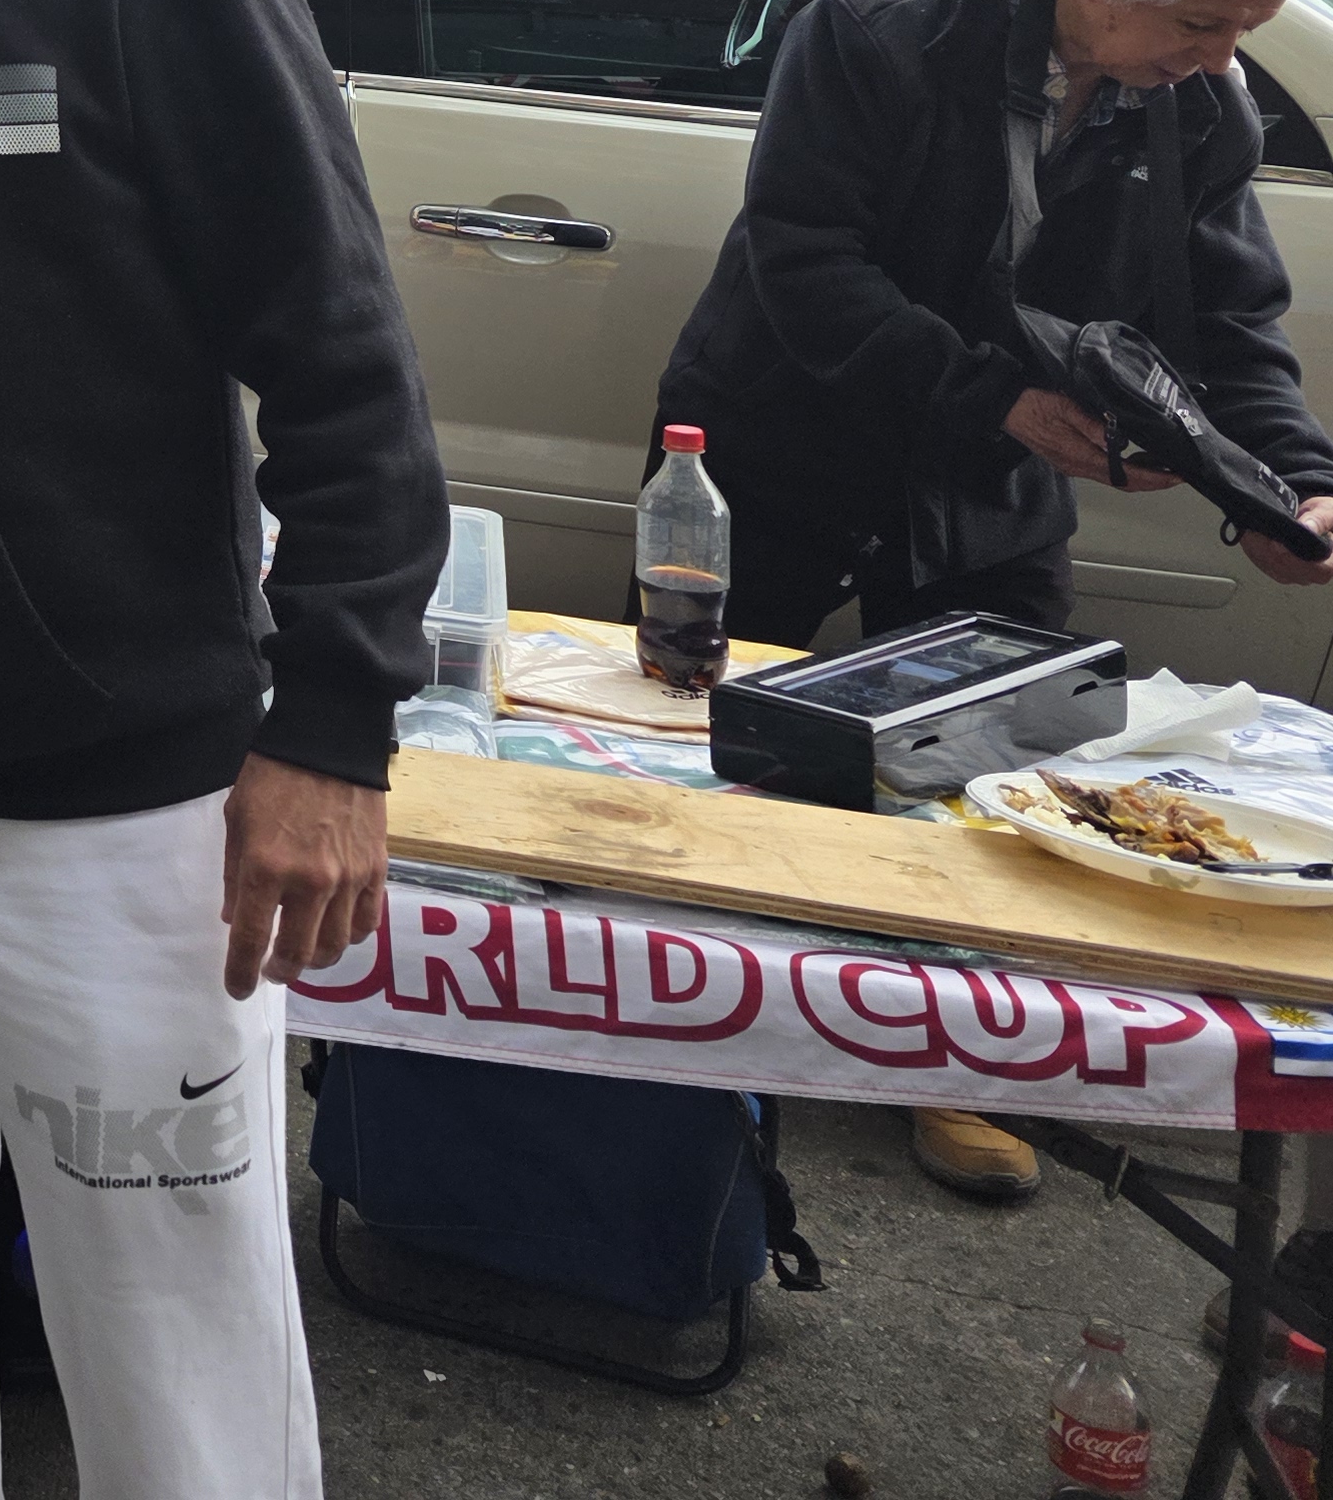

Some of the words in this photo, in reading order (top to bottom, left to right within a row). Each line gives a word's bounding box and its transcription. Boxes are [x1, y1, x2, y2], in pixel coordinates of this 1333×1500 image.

[789, 951, 1209, 1089] CUP
[54, 1155, 152, 1190] International
[157, 1158, 252, 1190] Sportswear
